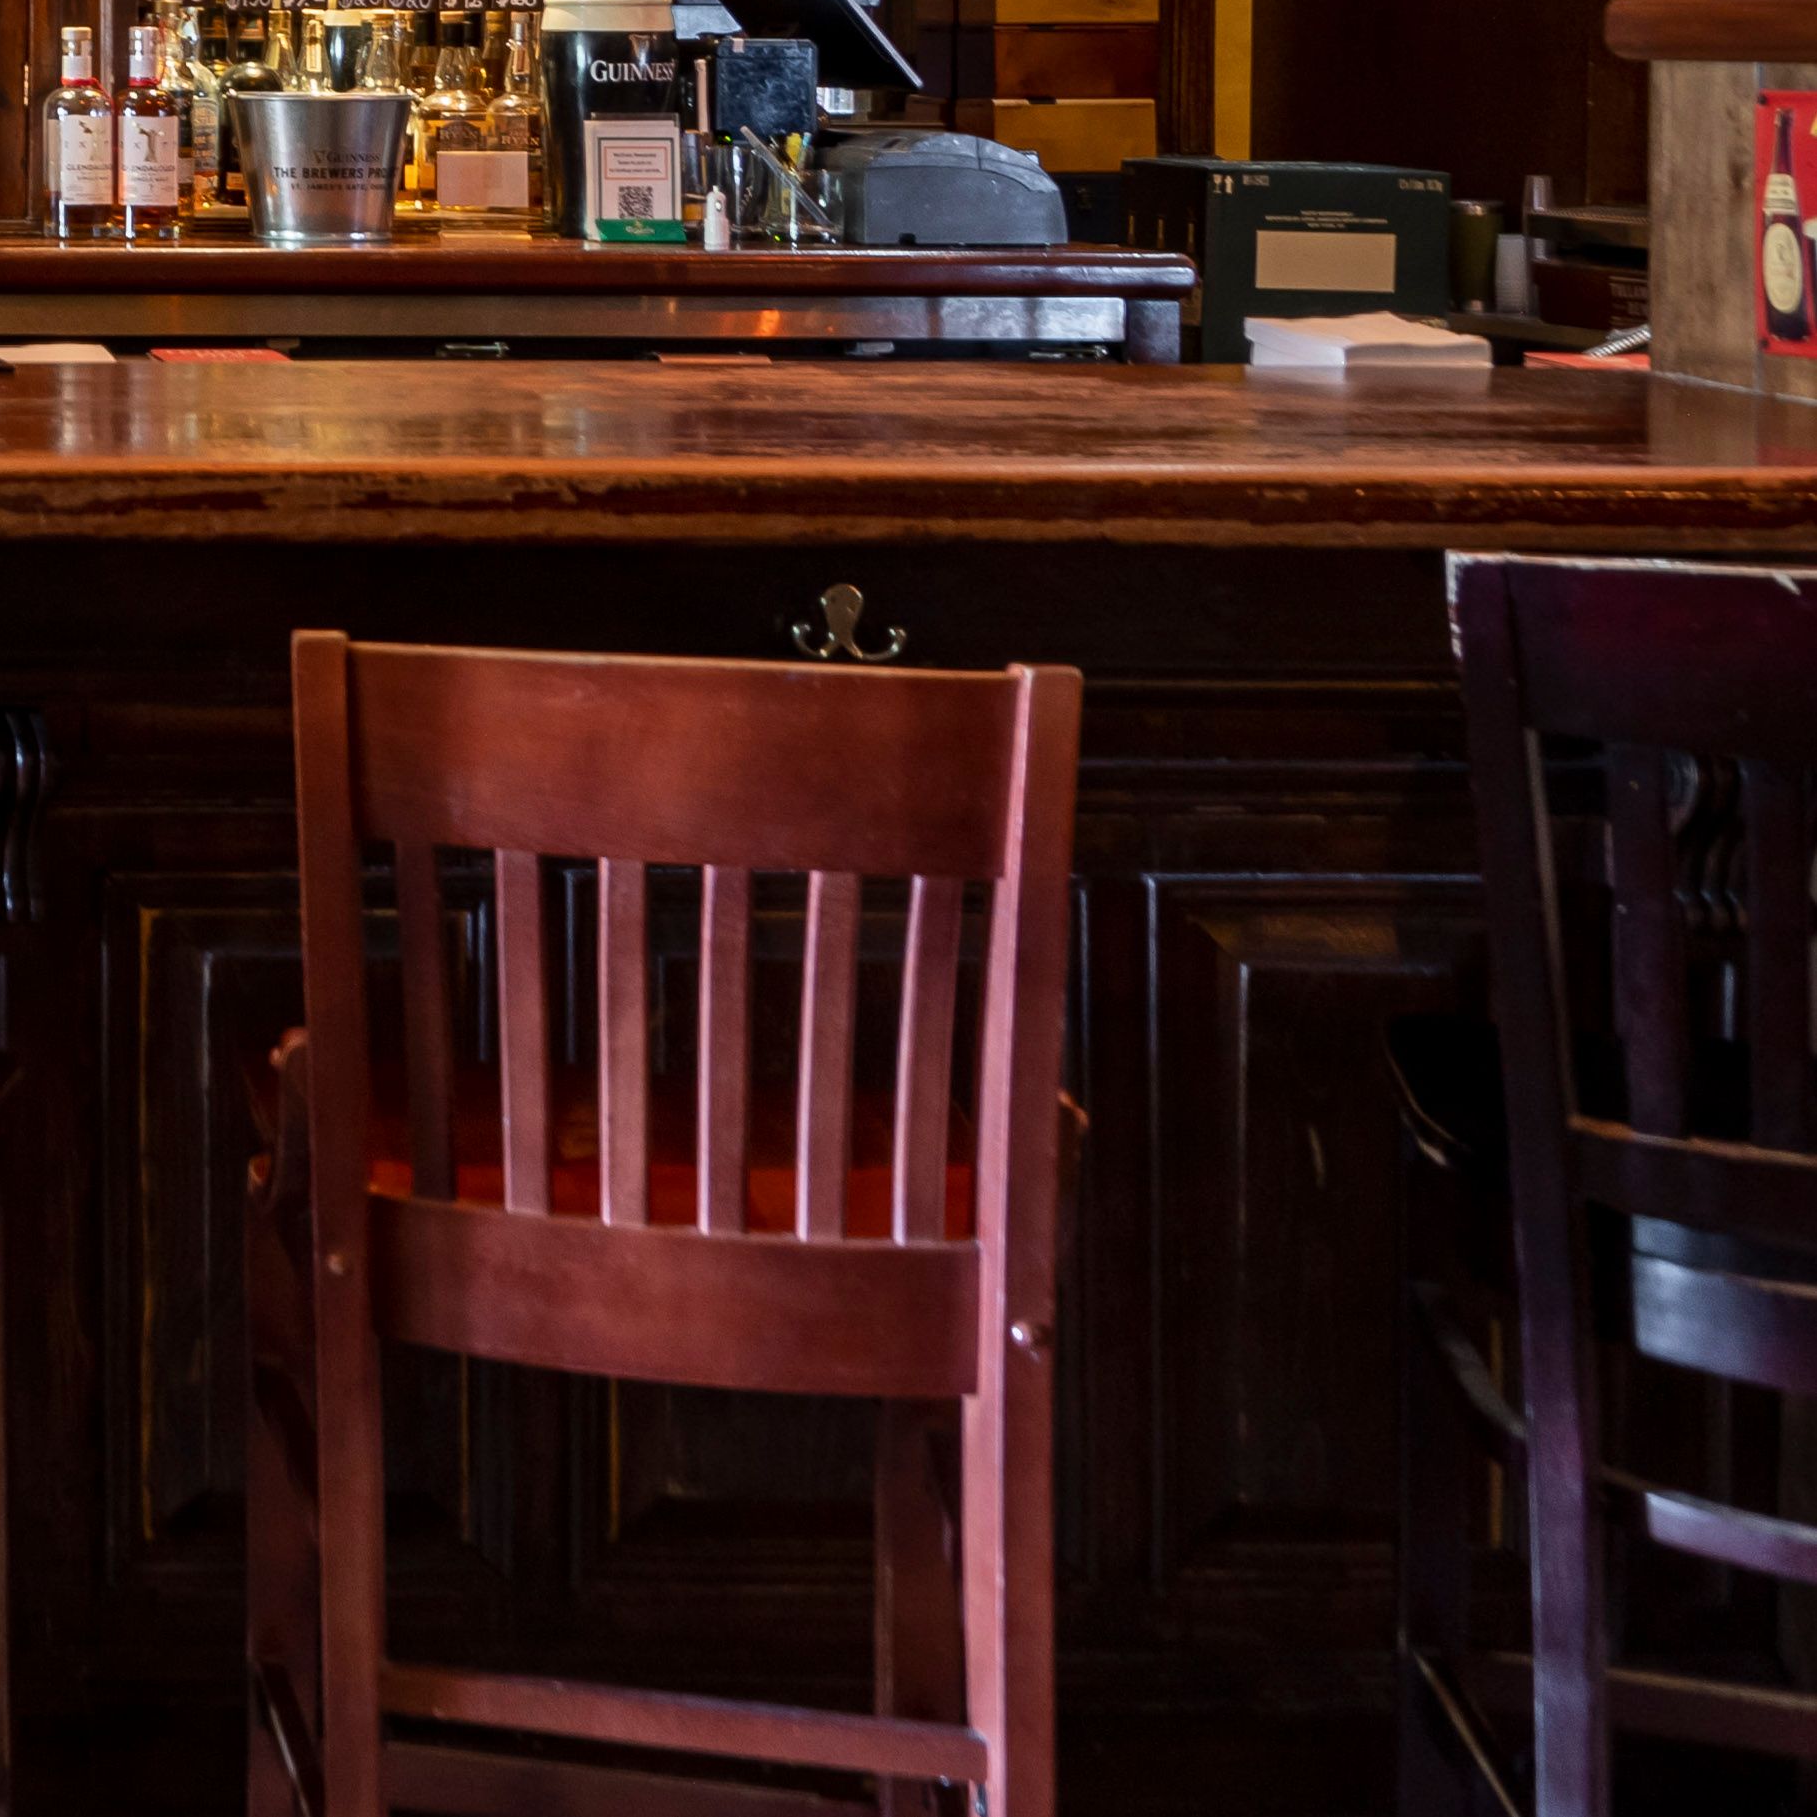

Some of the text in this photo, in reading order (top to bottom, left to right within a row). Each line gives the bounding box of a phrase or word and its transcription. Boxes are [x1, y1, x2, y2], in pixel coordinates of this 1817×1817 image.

[590, 59, 673, 82] GUINNESS
[274, 167, 364, 178] THE BREWERS
